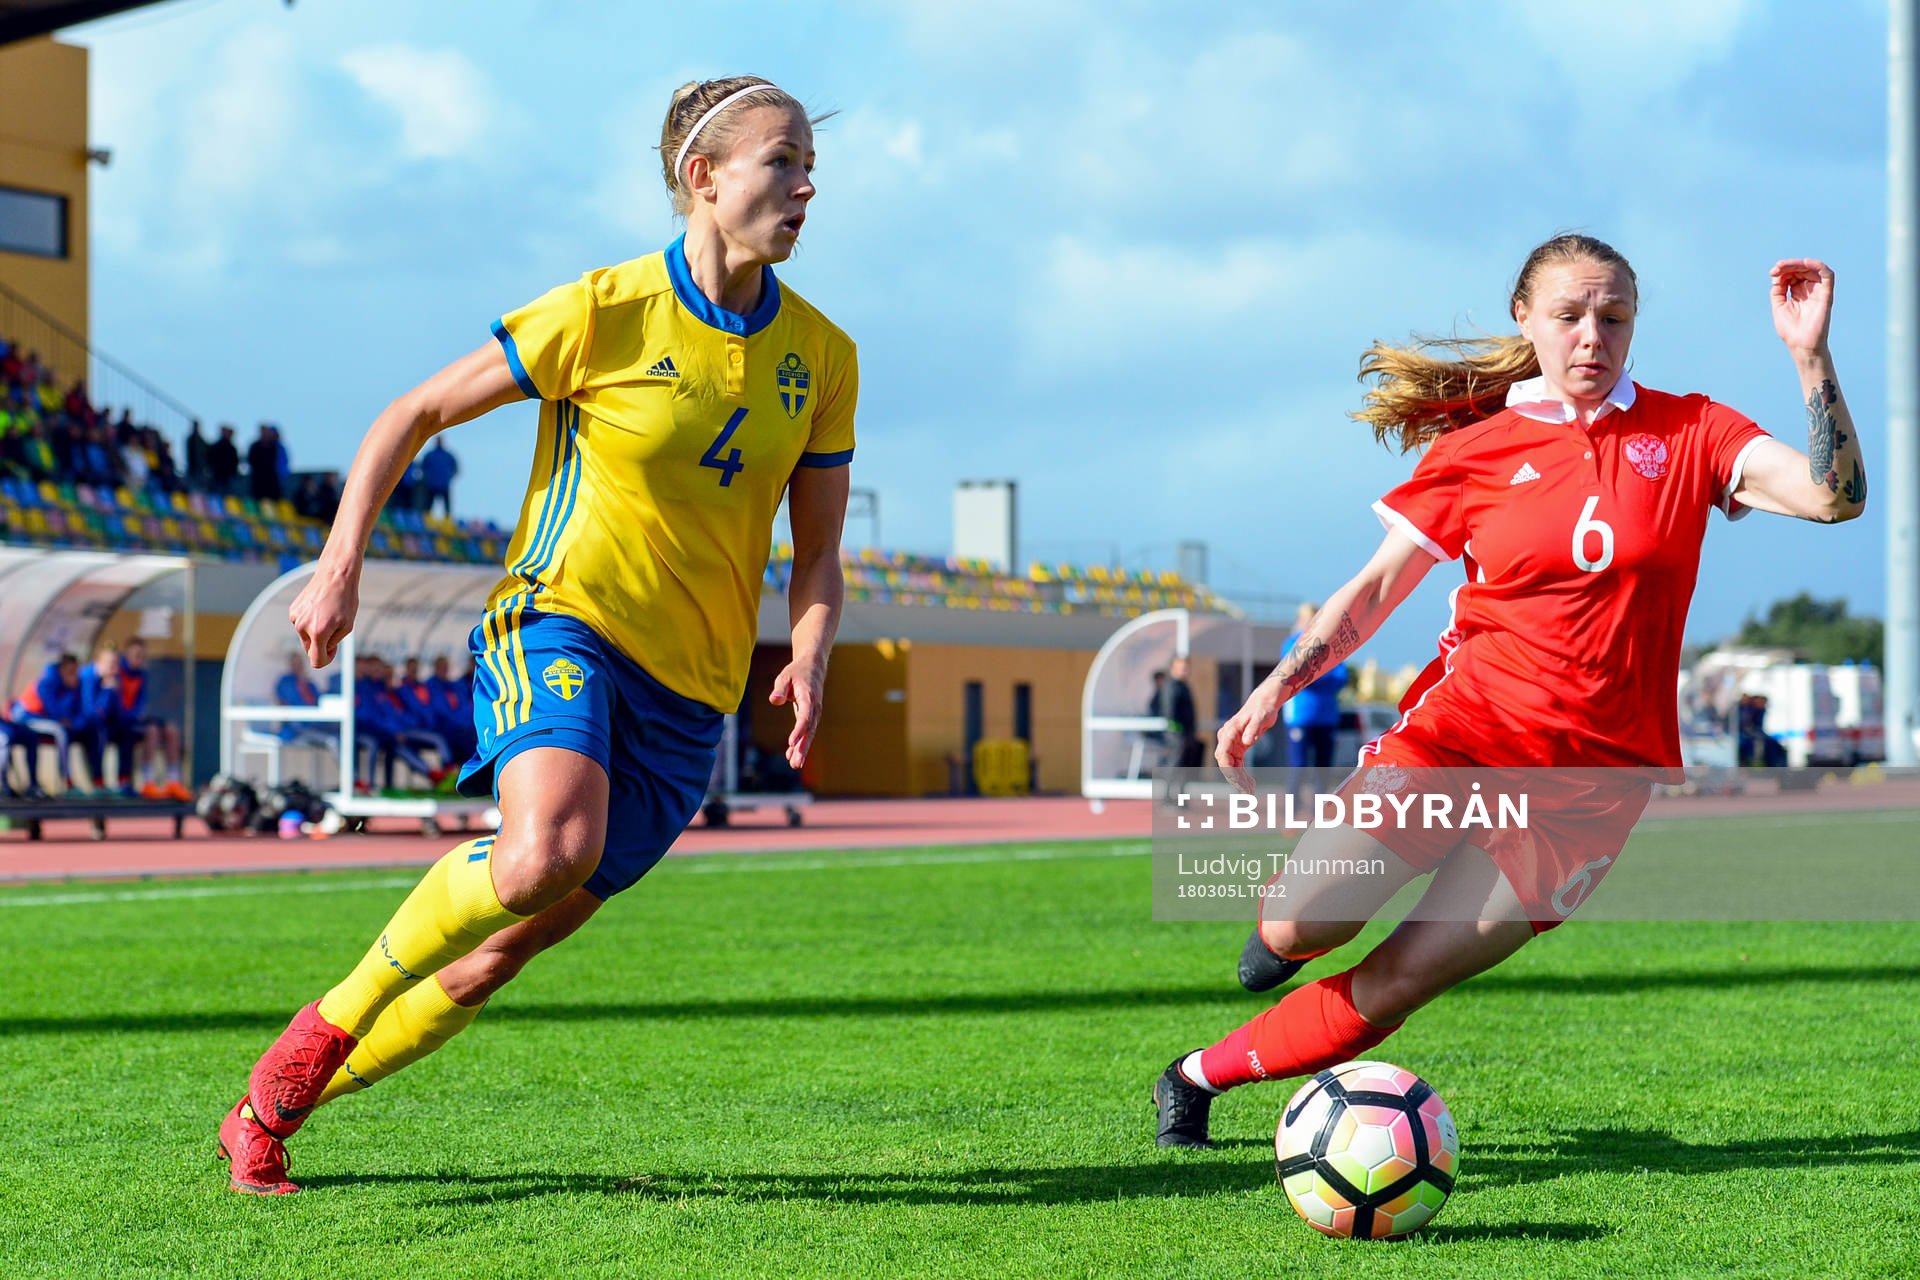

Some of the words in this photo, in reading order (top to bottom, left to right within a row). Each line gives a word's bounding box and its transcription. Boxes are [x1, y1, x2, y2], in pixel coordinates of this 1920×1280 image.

[646, 369, 681, 378] adidas
[698, 407, 749, 487] 4
[1572, 496, 1614, 572] 6
[1551, 855, 1611, 916] 6
